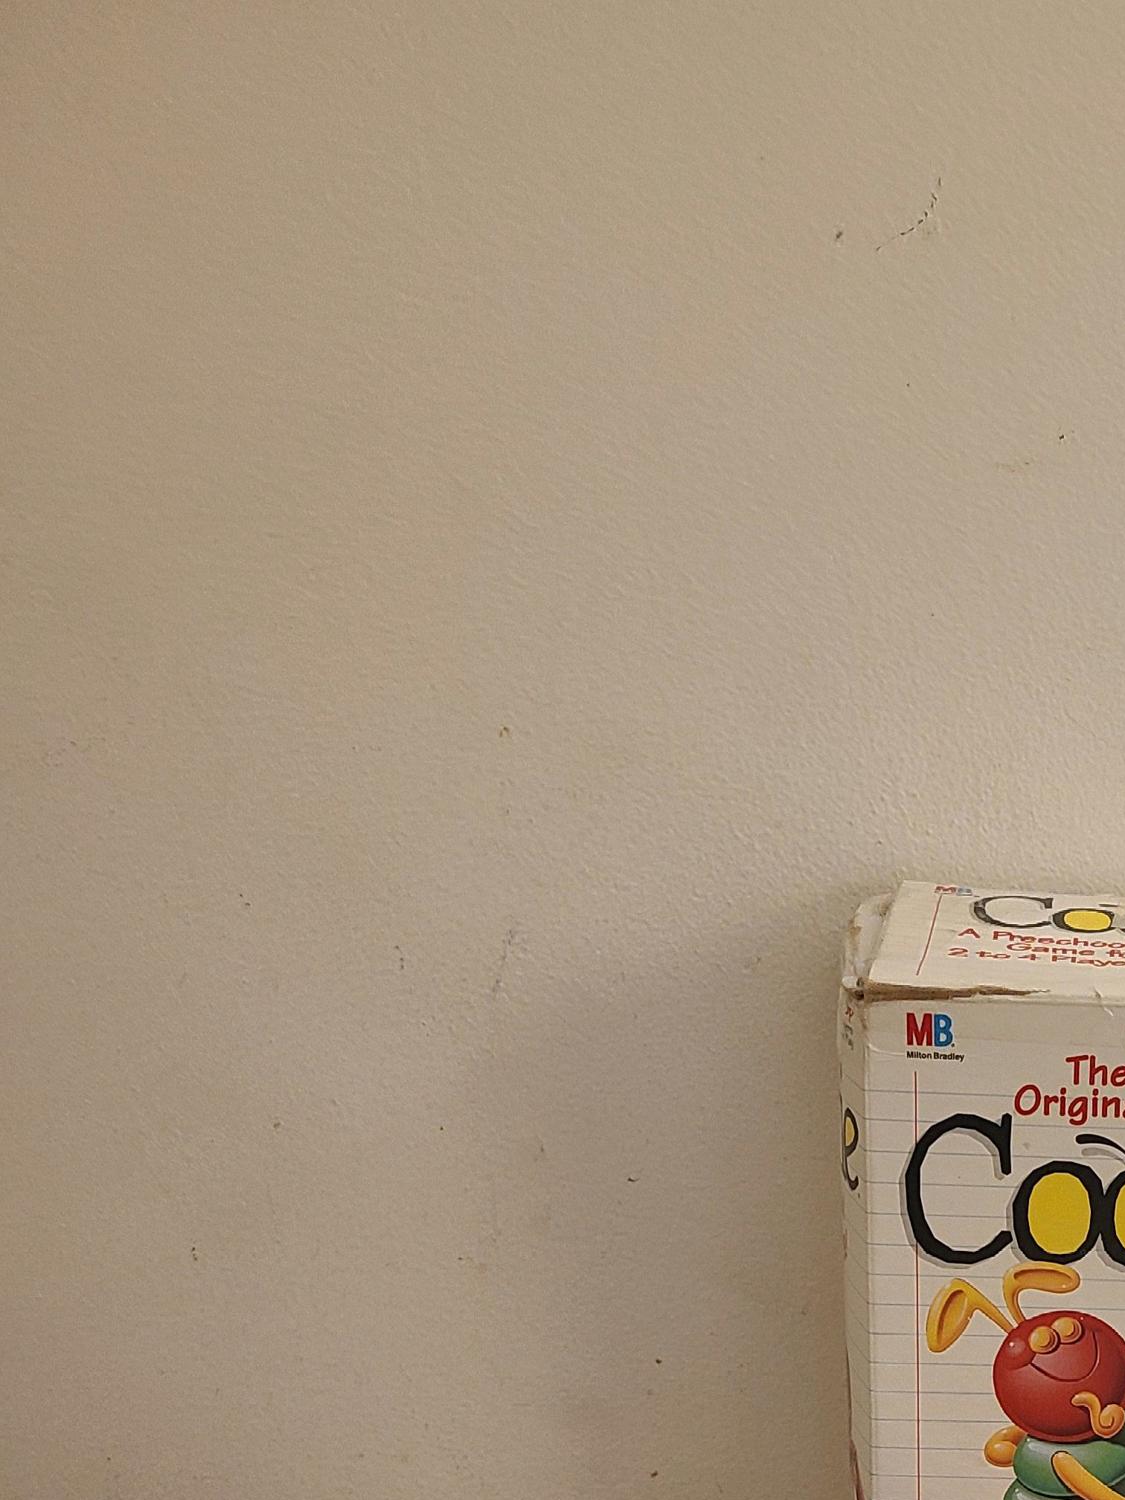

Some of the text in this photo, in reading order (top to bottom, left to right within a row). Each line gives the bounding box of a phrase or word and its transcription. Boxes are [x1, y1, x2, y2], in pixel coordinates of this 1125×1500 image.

[958, 928, 981, 939] A
[947, 948, 969, 958] 2
[975, 951, 1011, 960] to
[1018, 953, 1041, 961] 4
[1006, 943, 1096, 956] Game
[906, 1051, 965, 1062] Milton Bradley
